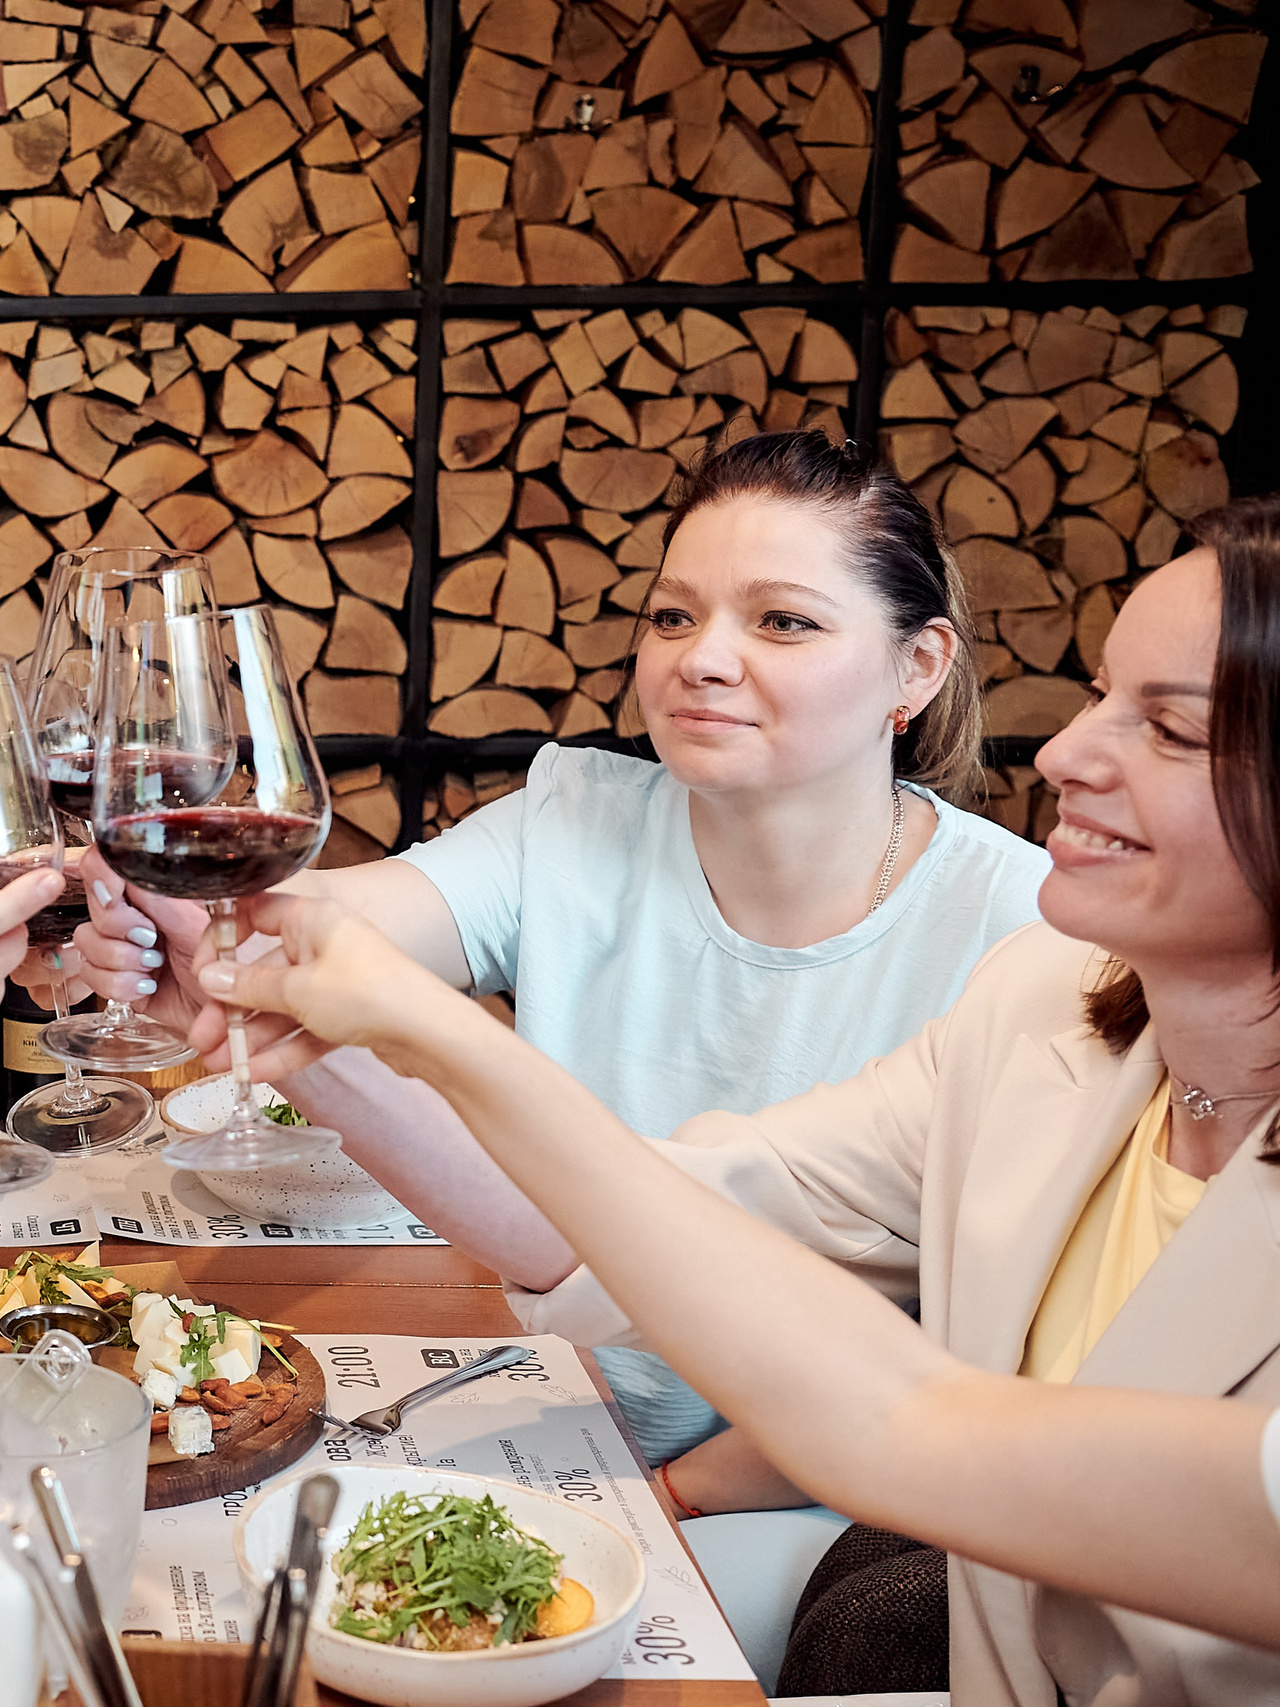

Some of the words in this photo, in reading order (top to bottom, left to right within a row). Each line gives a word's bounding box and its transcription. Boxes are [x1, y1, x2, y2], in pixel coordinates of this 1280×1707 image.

[206, 1214, 248, 1239] 30%
[327, 1346, 381, 1389] 21:00
[322, 1438, 353, 1463] ова
[395, 1433, 425, 1467] крытие!
[498, 1439, 531, 1474] рождения
[553, 1468, 603, 1503] 30%
[633, 1614, 695, 1666] 30%
